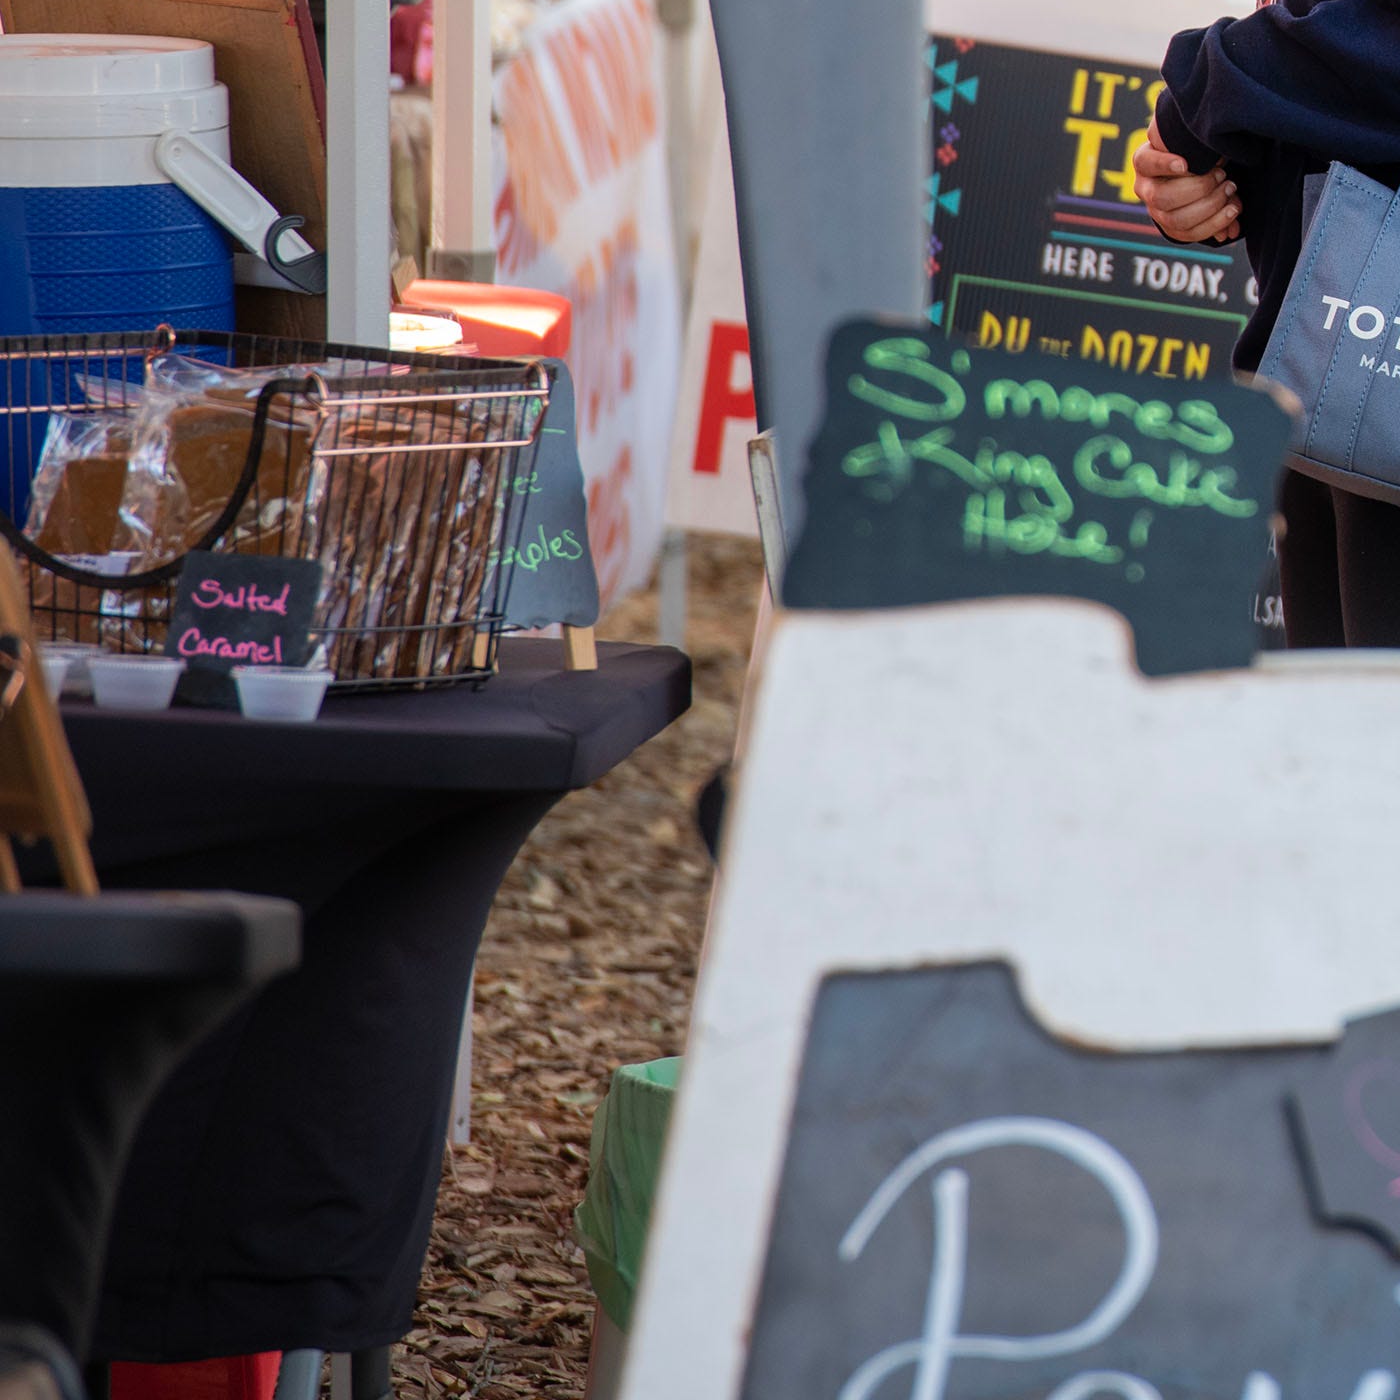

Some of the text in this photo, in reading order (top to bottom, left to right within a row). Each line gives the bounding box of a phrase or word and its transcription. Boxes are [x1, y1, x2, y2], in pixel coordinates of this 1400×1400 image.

[1041, 243, 1114, 282] HERE
[1133, 256, 1228, 303] TODAY,
[191, 579, 291, 615] Salted
[178, 627, 283, 663] Caramel
